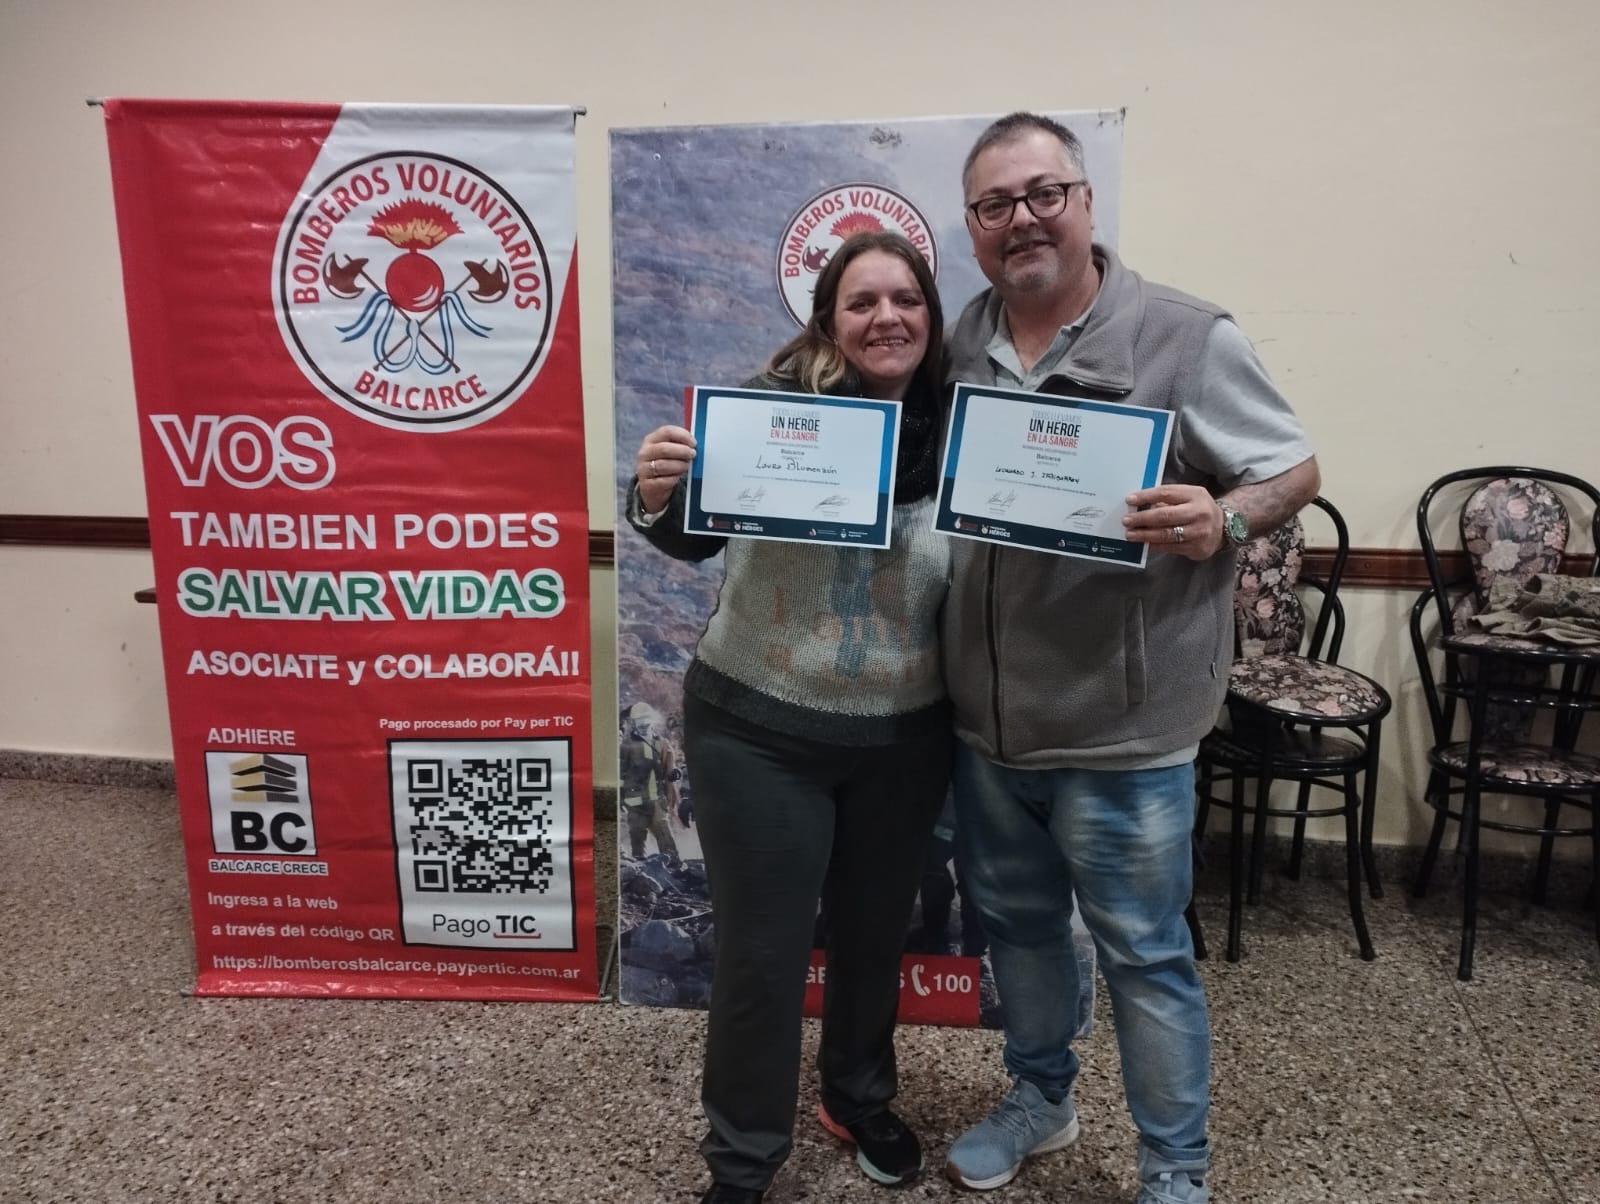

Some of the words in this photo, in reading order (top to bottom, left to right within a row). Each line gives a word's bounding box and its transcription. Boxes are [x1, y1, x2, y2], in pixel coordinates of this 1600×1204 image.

[292, 165, 391, 305] BOMBEROS
[395, 162, 541, 311] VOLUNTARIOS
[784, 193, 845, 278] BOMBEROS
[848, 190, 931, 263] VOLUNTARI
[353, 371, 487, 412] BALCARCE
[771, 415, 785, 429] UN
[1029, 418, 1044, 433] UN
[770, 428, 780, 439] EN
[781, 429, 790, 440] LA
[791, 430, 819, 442] SANGRE
[1027, 431, 1037, 442] EN
[1038, 433, 1048, 445] LA
[1048, 435, 1078, 449] SANGRE
[148, 413, 336, 491] VOS
[170, 511, 377, 550] TAMBIEN
[394, 512, 560, 550] PODES
[178, 568, 391, 620] SALVAR
[393, 569, 565, 619] VIDAS
[186, 649, 339, 681] ASOCIATE
[347, 658, 367, 687] y
[374, 645, 580, 679] COLABORÁ!!
[379, 718, 411, 732] Pago
[413, 718, 478, 731] procesado
[480, 719, 500, 731] por
[504, 716, 527, 730] Pay
[530, 717, 550, 730] per
[552, 715, 575, 728] TIC
[207, 727, 297, 746] ADHIERE
[230, 810, 308, 853] BC
[210, 860, 280, 873] BALCARCE
[283, 862, 328, 875] CRECE
[207, 891, 269, 909] Ingresa
[272, 896, 283, 907] a
[287, 894, 302, 908] la
[305, 896, 339, 910] web
[211, 924, 222, 936] a
[225, 922, 276, 937] través
[280, 923, 305, 937] del
[309, 925, 365, 941] código
[368, 927, 395, 941] QR
[432, 913, 491, 938] Pago
[495, 914, 537, 935] TIC
[212, 954, 581, 980] https://bomberosbalcarce.paypertic.com.ar
[932, 973, 973, 993] 100
